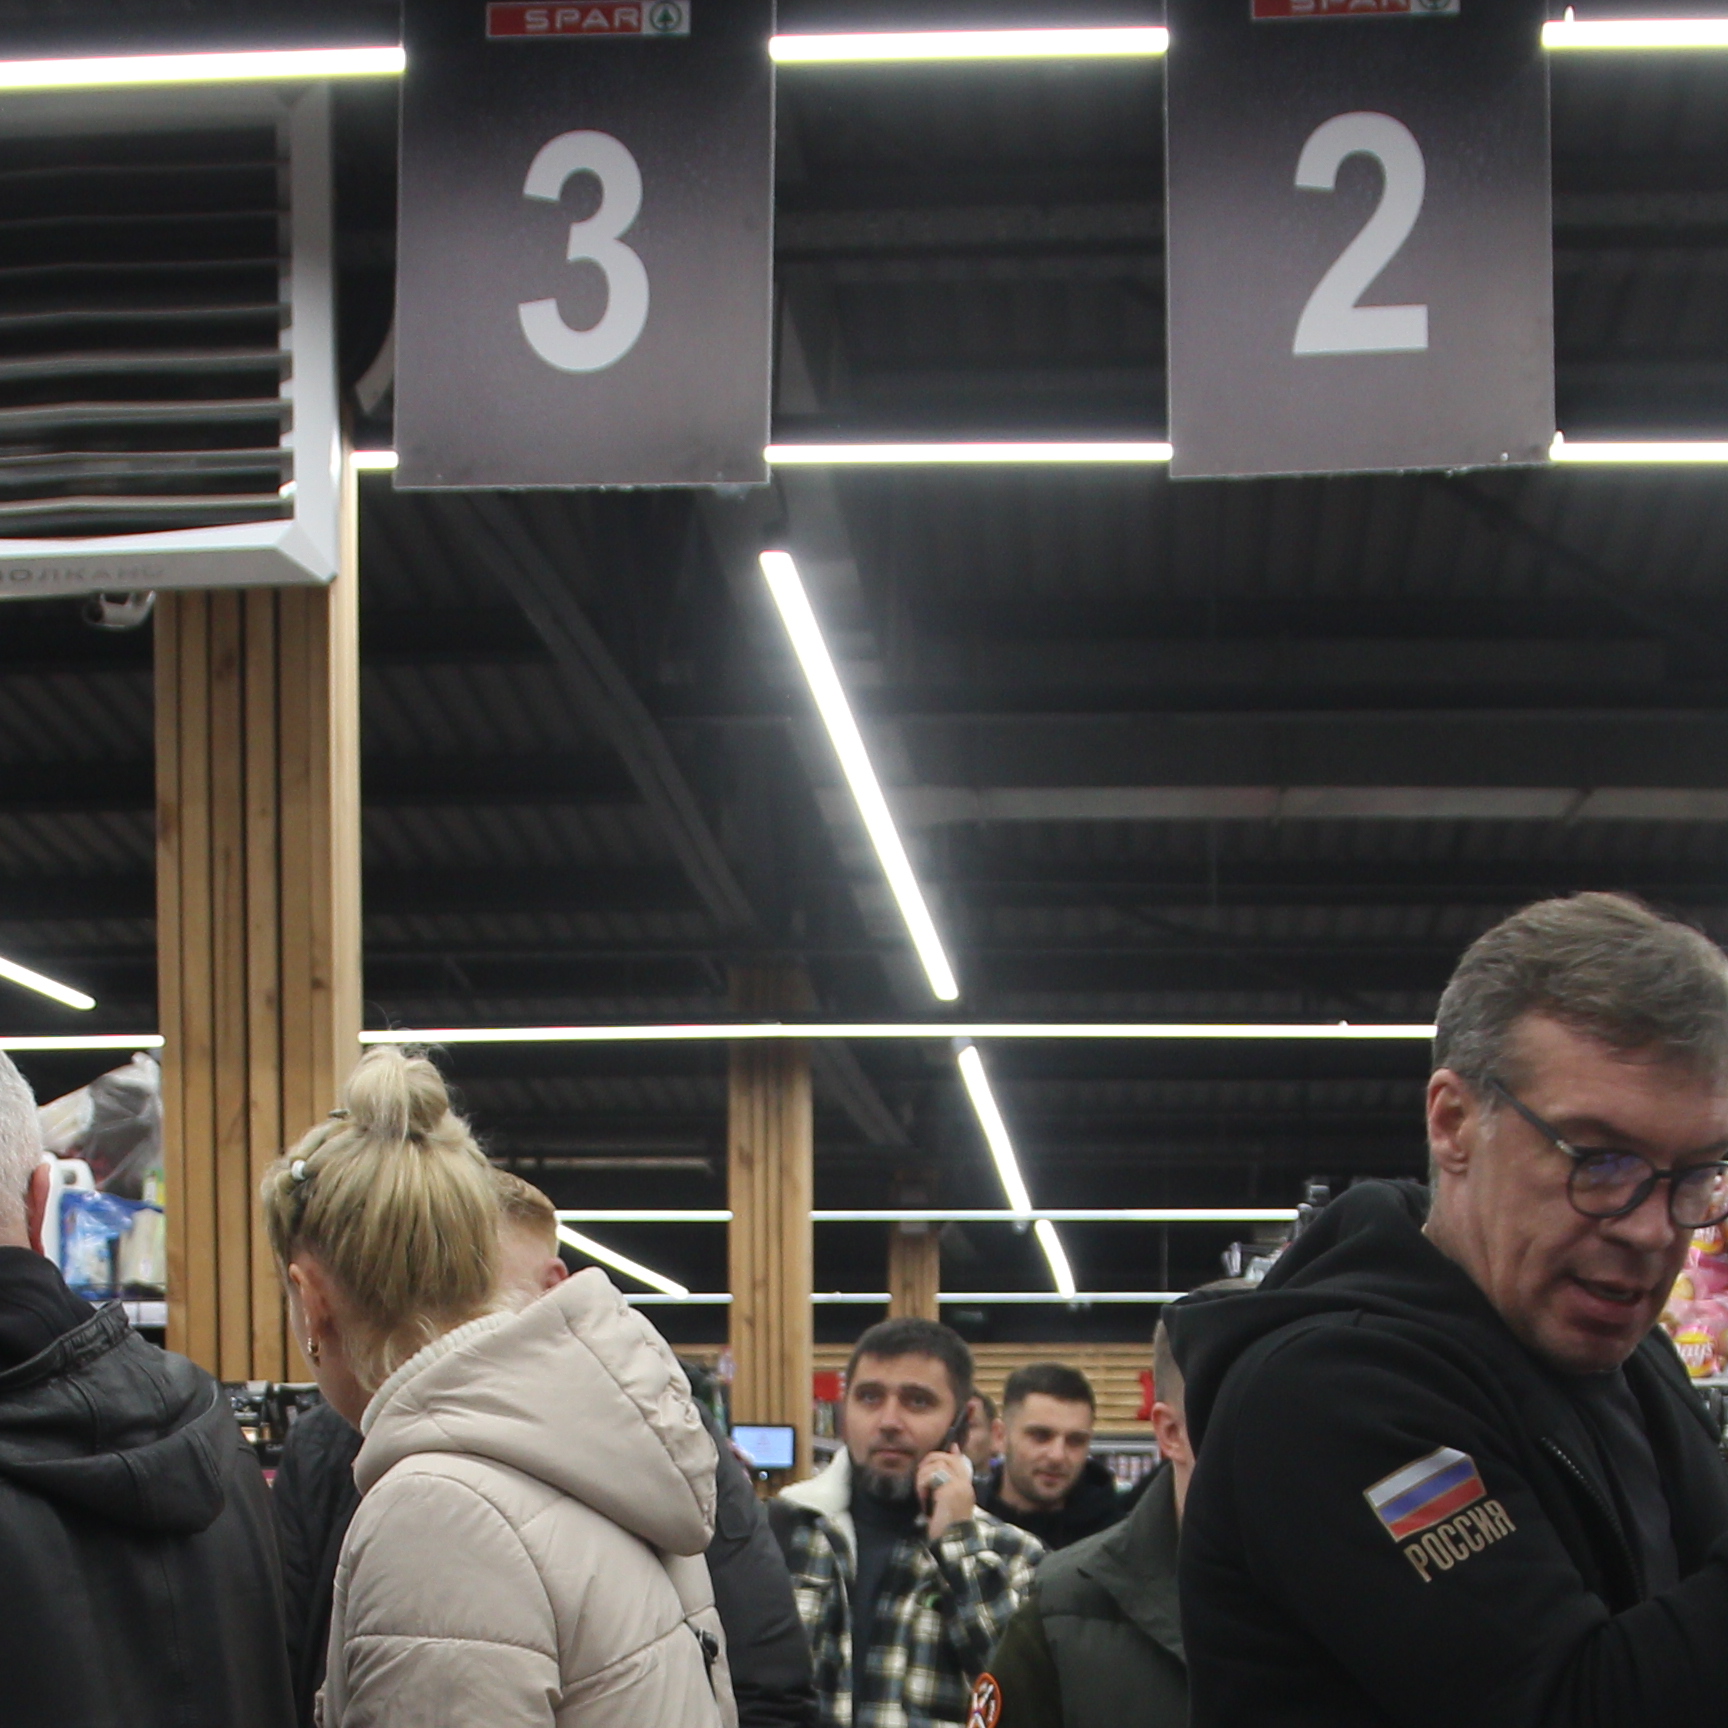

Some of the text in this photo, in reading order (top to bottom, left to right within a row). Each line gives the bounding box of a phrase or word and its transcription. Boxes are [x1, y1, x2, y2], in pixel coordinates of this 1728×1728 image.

[524, 8, 640, 31] SPAR
[518, 129, 650, 374] 3
[1292, 110, 1429, 356] 2
[1404, 1500, 1517, 1583] РОССИЯ
